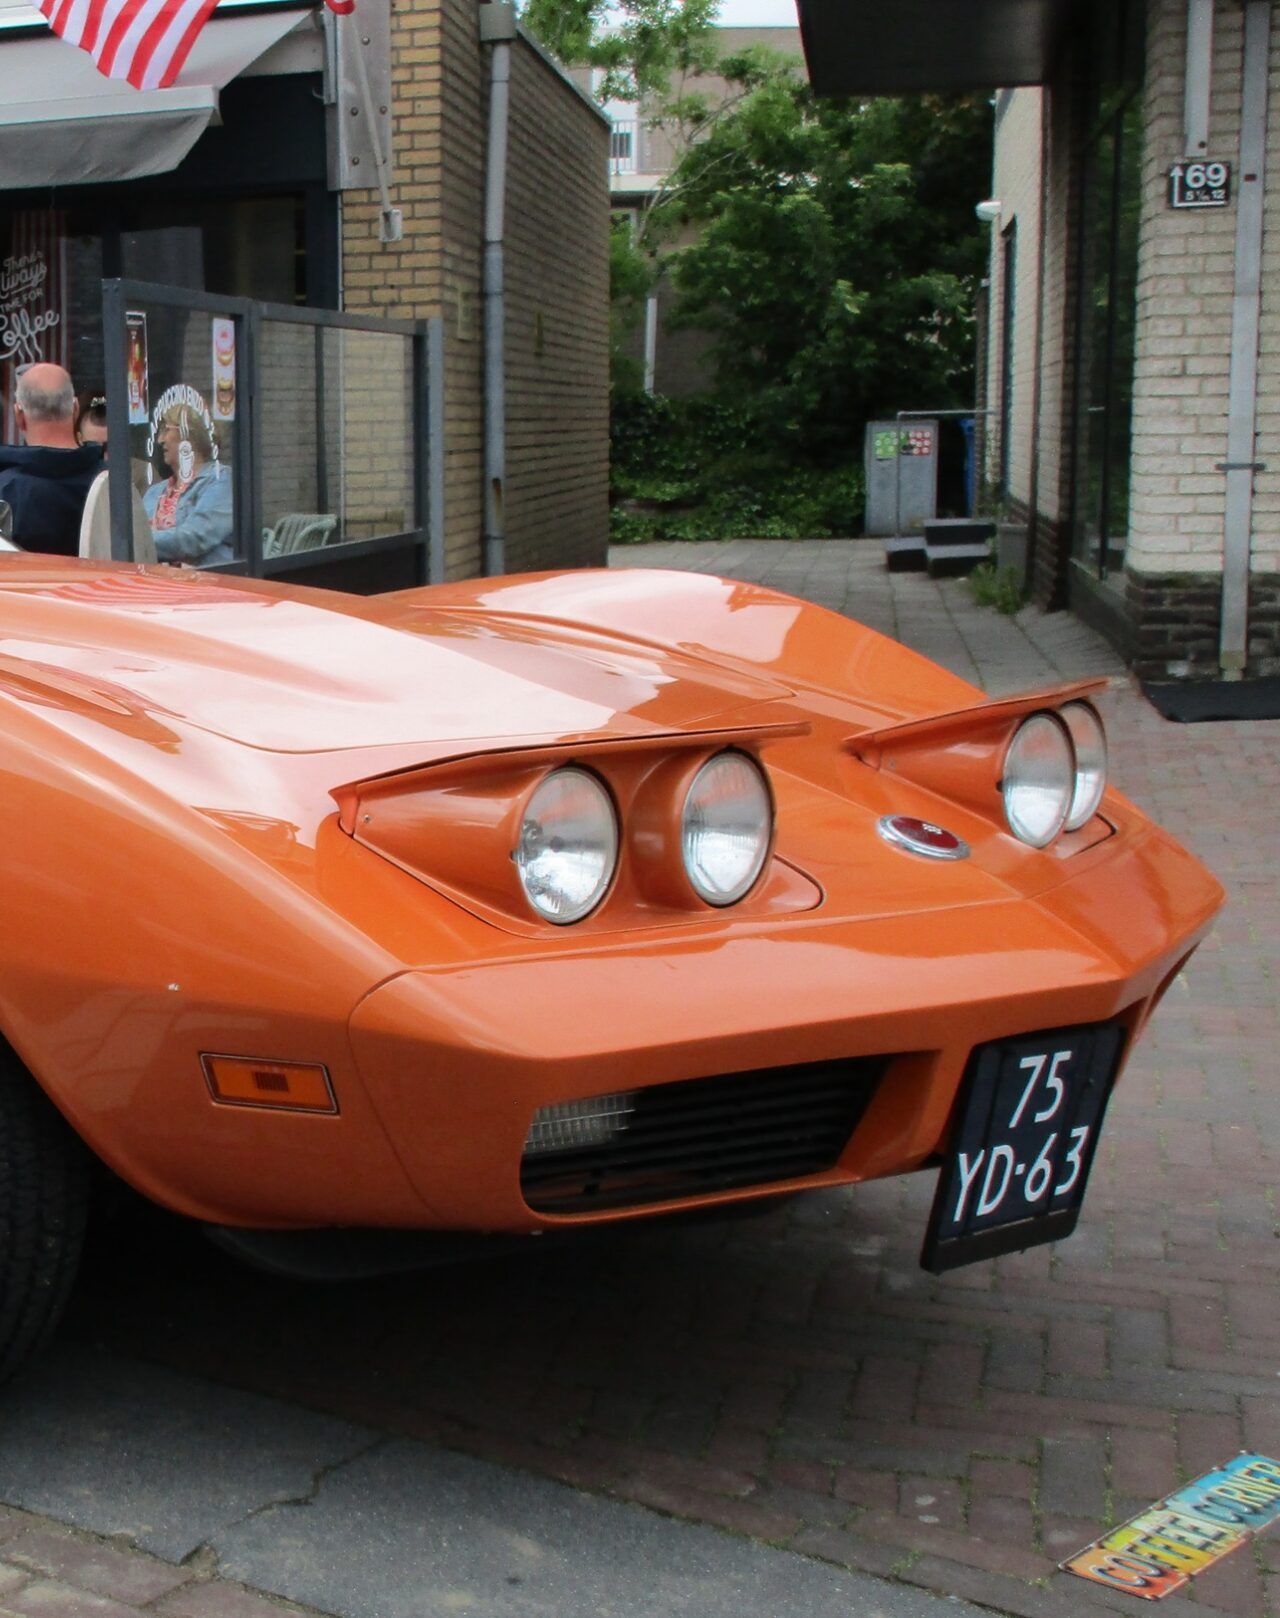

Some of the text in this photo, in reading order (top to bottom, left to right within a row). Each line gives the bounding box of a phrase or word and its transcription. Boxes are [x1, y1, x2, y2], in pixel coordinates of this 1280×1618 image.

[1185, 163, 1227, 189] 69
[22, 287, 44, 302] FOR
[1008, 1050, 1073, 1129] 75
[952, 1125, 1090, 1222] YD-63
[1089, 1513, 1227, 1587] COFFEE
